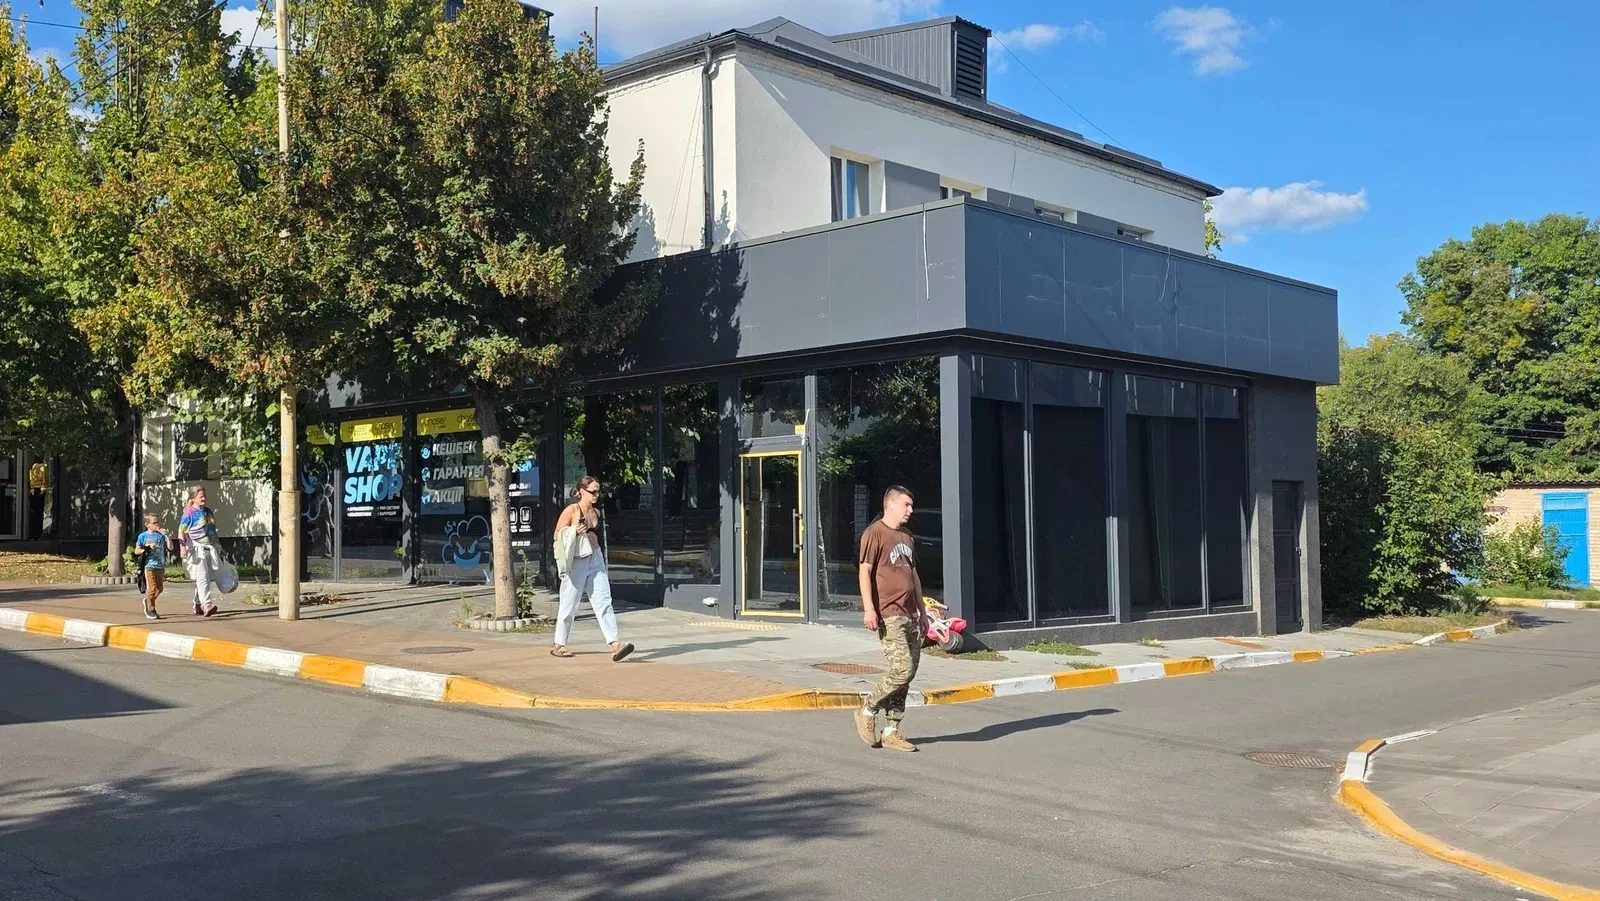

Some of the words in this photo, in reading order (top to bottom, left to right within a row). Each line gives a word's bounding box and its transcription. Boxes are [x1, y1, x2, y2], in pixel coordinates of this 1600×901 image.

[346, 443, 401, 473] VAPE
[432, 441, 477, 456] КЕШБЕК
[432, 464, 485, 480] ГАРАНТІЯ
[344, 474, 403, 504] SHOP
